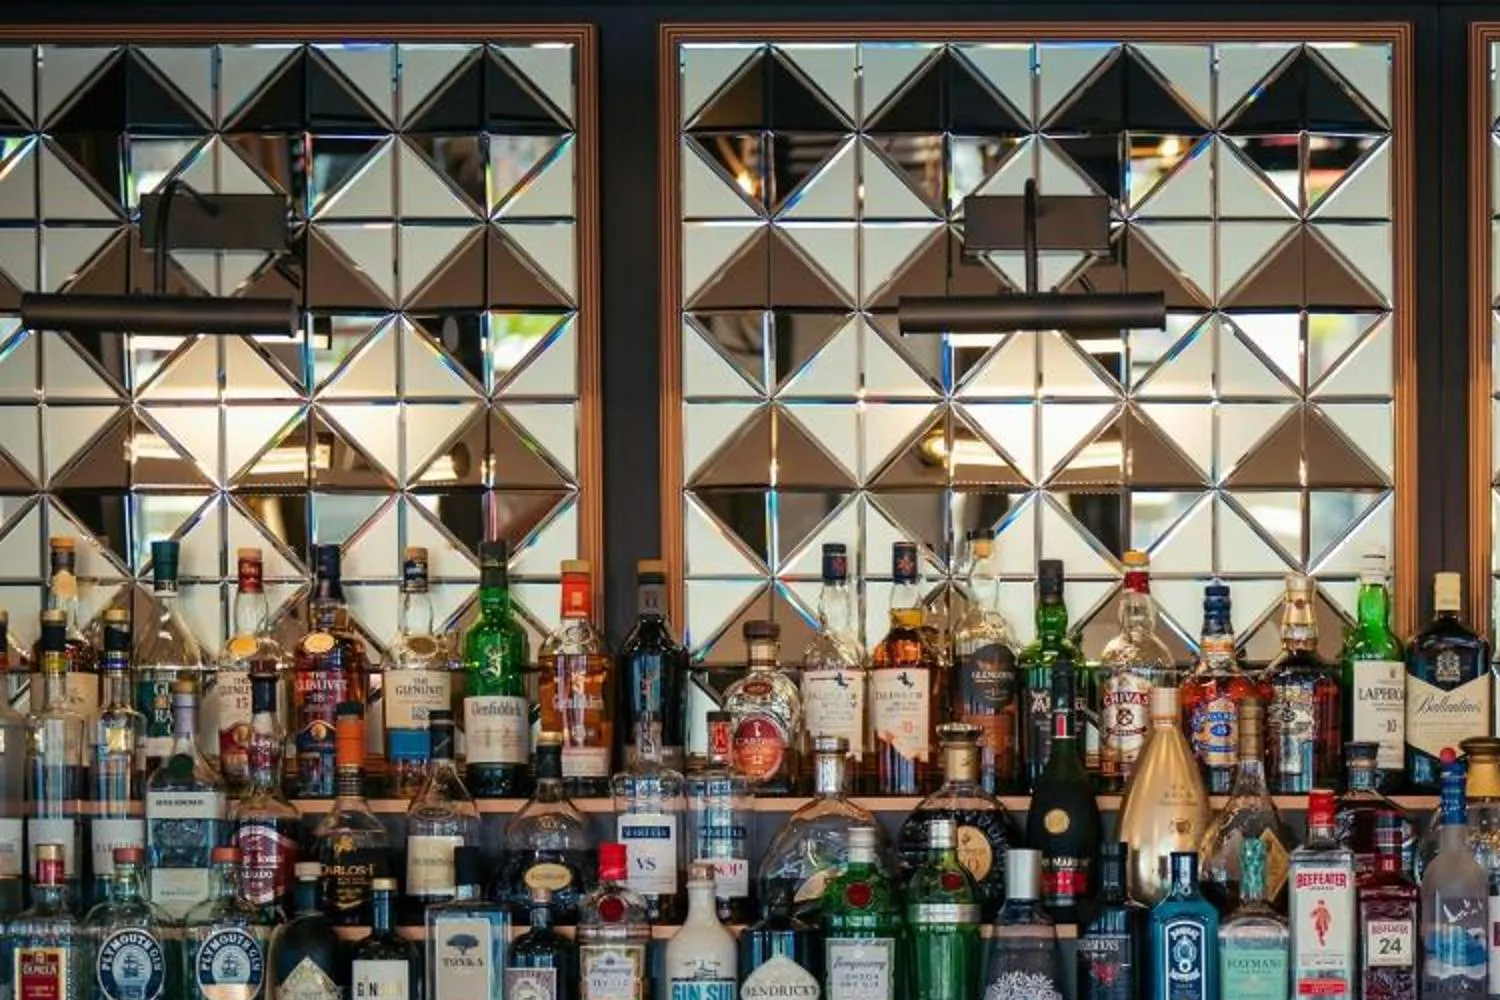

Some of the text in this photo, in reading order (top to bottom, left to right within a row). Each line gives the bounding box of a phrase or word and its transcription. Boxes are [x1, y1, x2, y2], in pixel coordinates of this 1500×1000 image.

[1104, 691, 1151, 706] CHIVAS
[1296, 871, 1347, 889] BEEFEATER
[1378, 938, 1402, 955] 24
